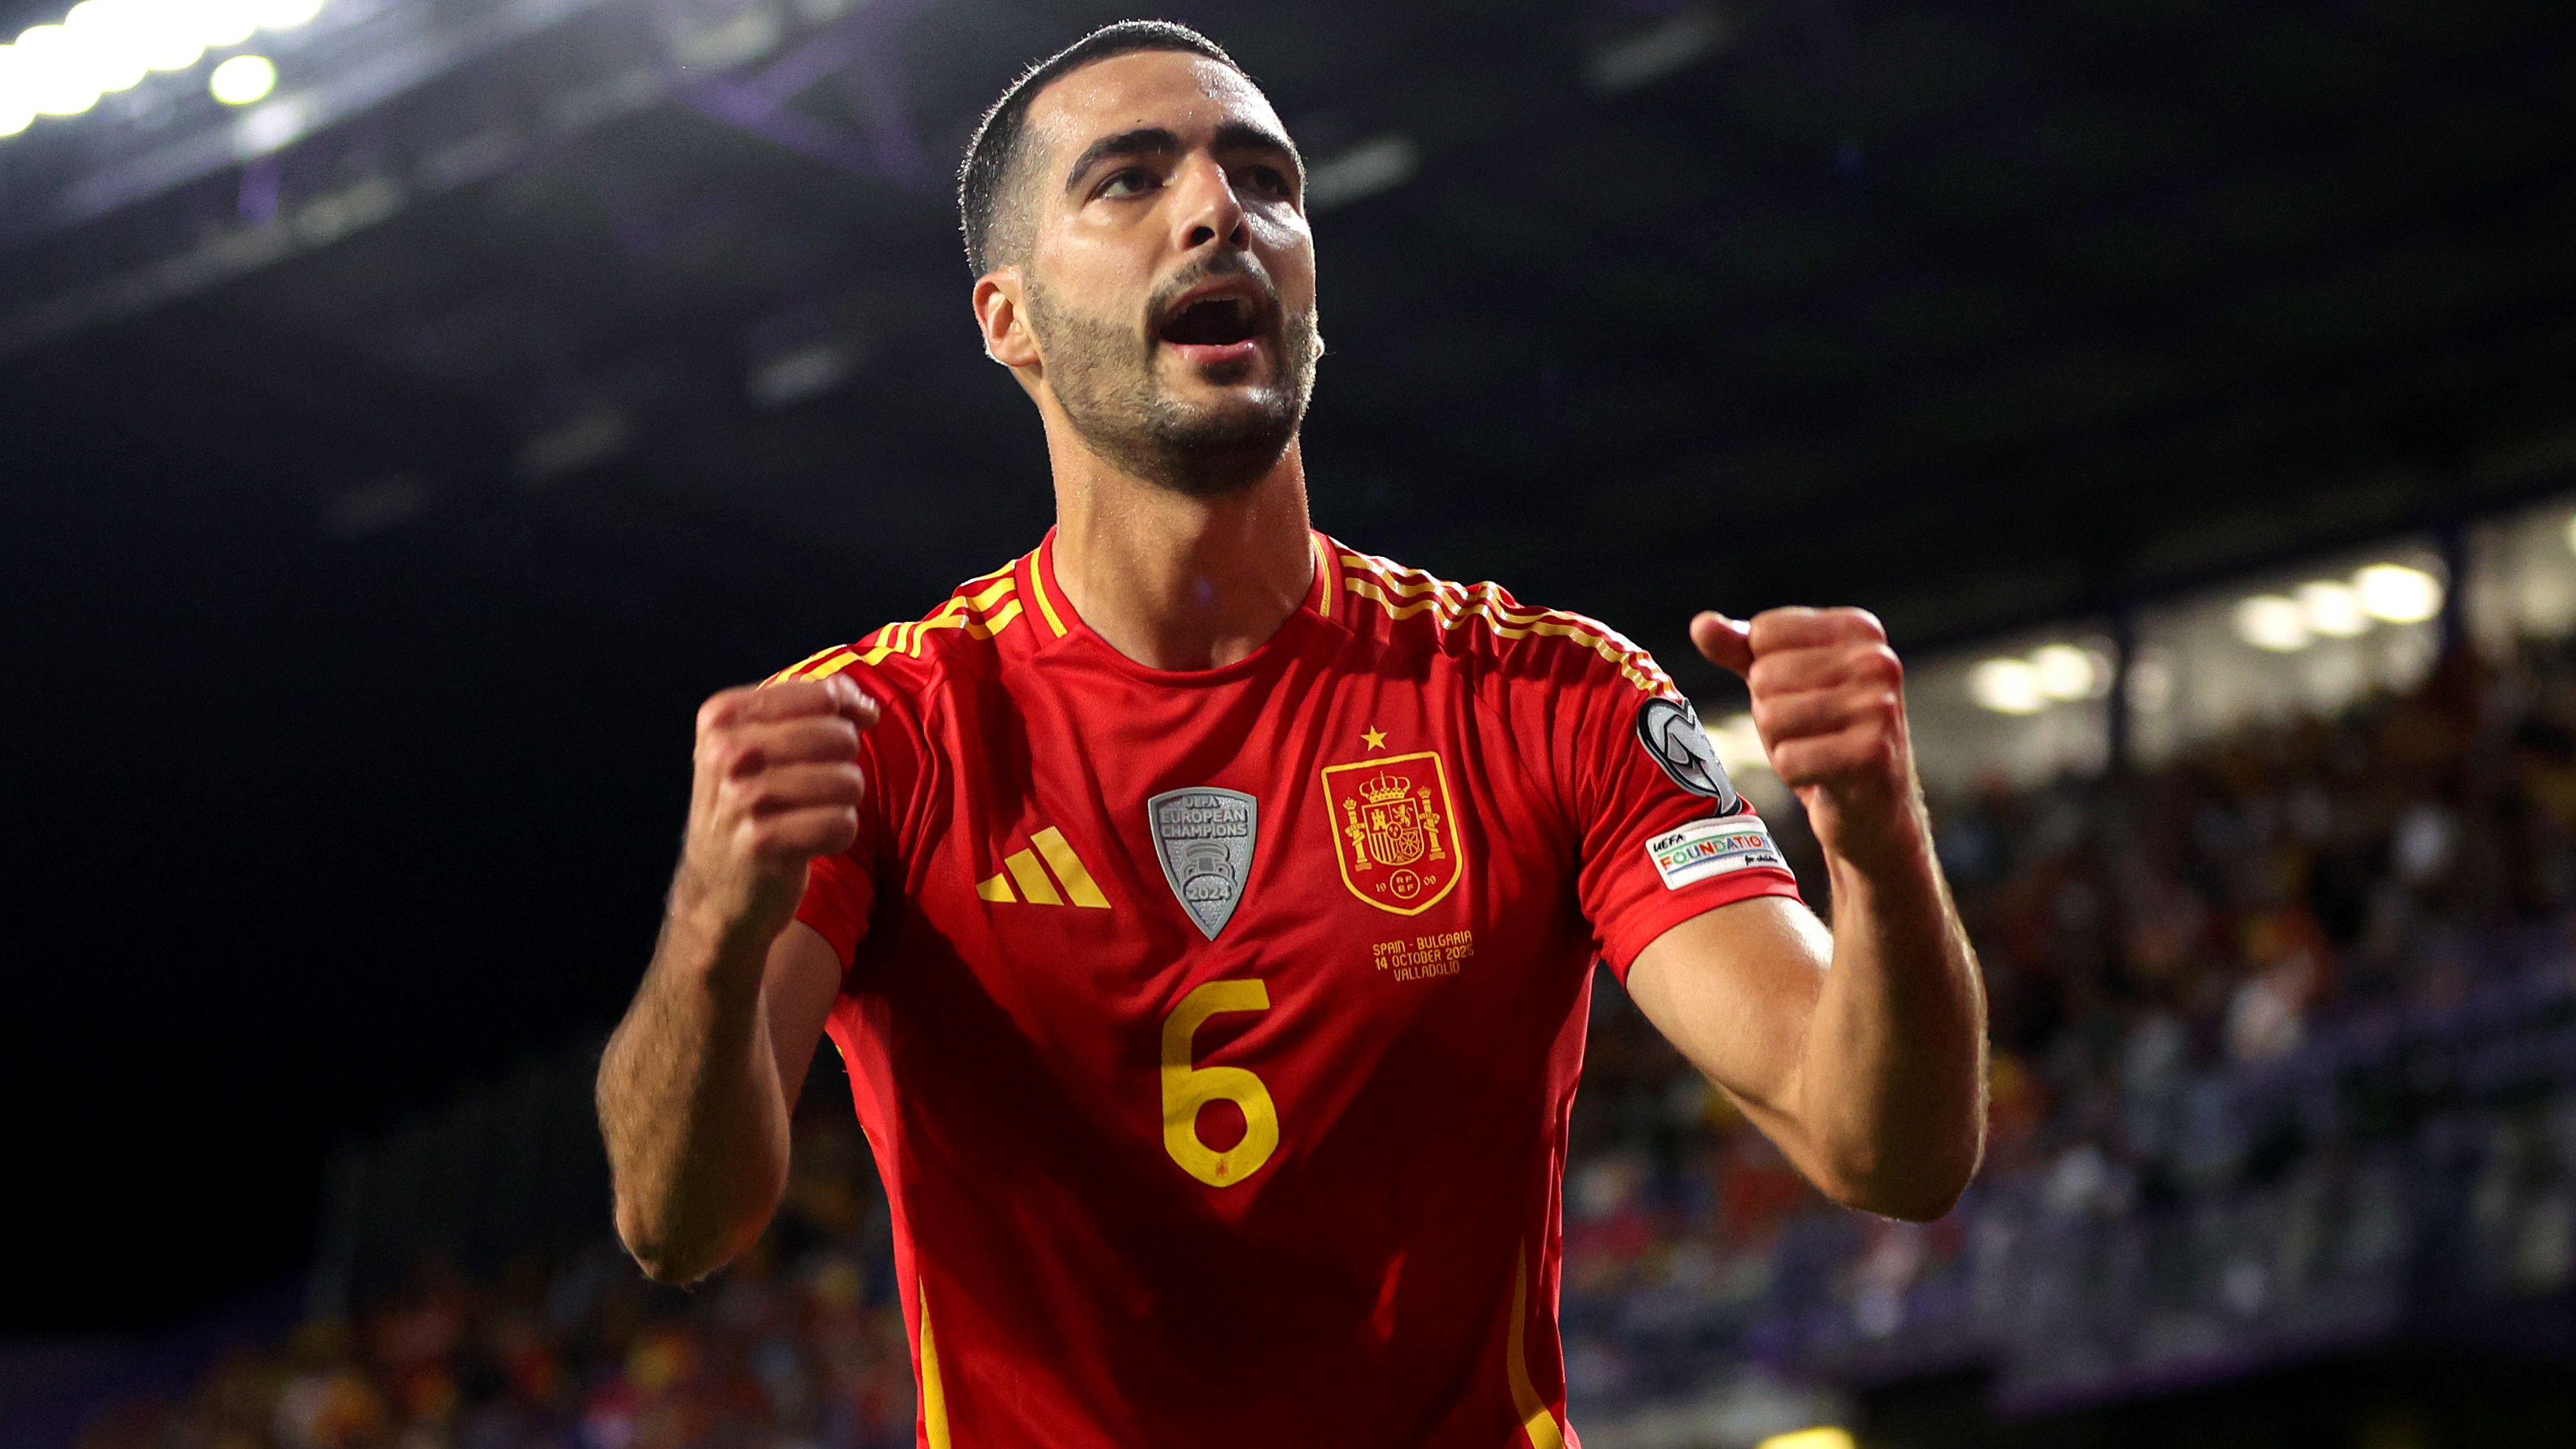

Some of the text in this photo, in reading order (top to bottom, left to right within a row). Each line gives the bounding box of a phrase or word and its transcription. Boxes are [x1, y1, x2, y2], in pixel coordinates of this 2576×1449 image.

[1185, 796, 1220, 809] UEFA
[1161, 809, 1246, 823] EUROPEAN
[1162, 823, 1247, 837] CHAMPIONS
[1653, 834, 1684, 852] UEFA
[1660, 834, 1771, 869] FOUNDATION
[1189, 888, 1229, 900] 2024
[1372, 940, 1406, 956] SPAIN
[1416, 930, 1472, 950] BULGARIA
[1375, 944, 1474, 971] 14 OCTOBER 2025
[1393, 961, 1460, 982] VALLADOLID
[1161, 978, 1280, 1188] 6
